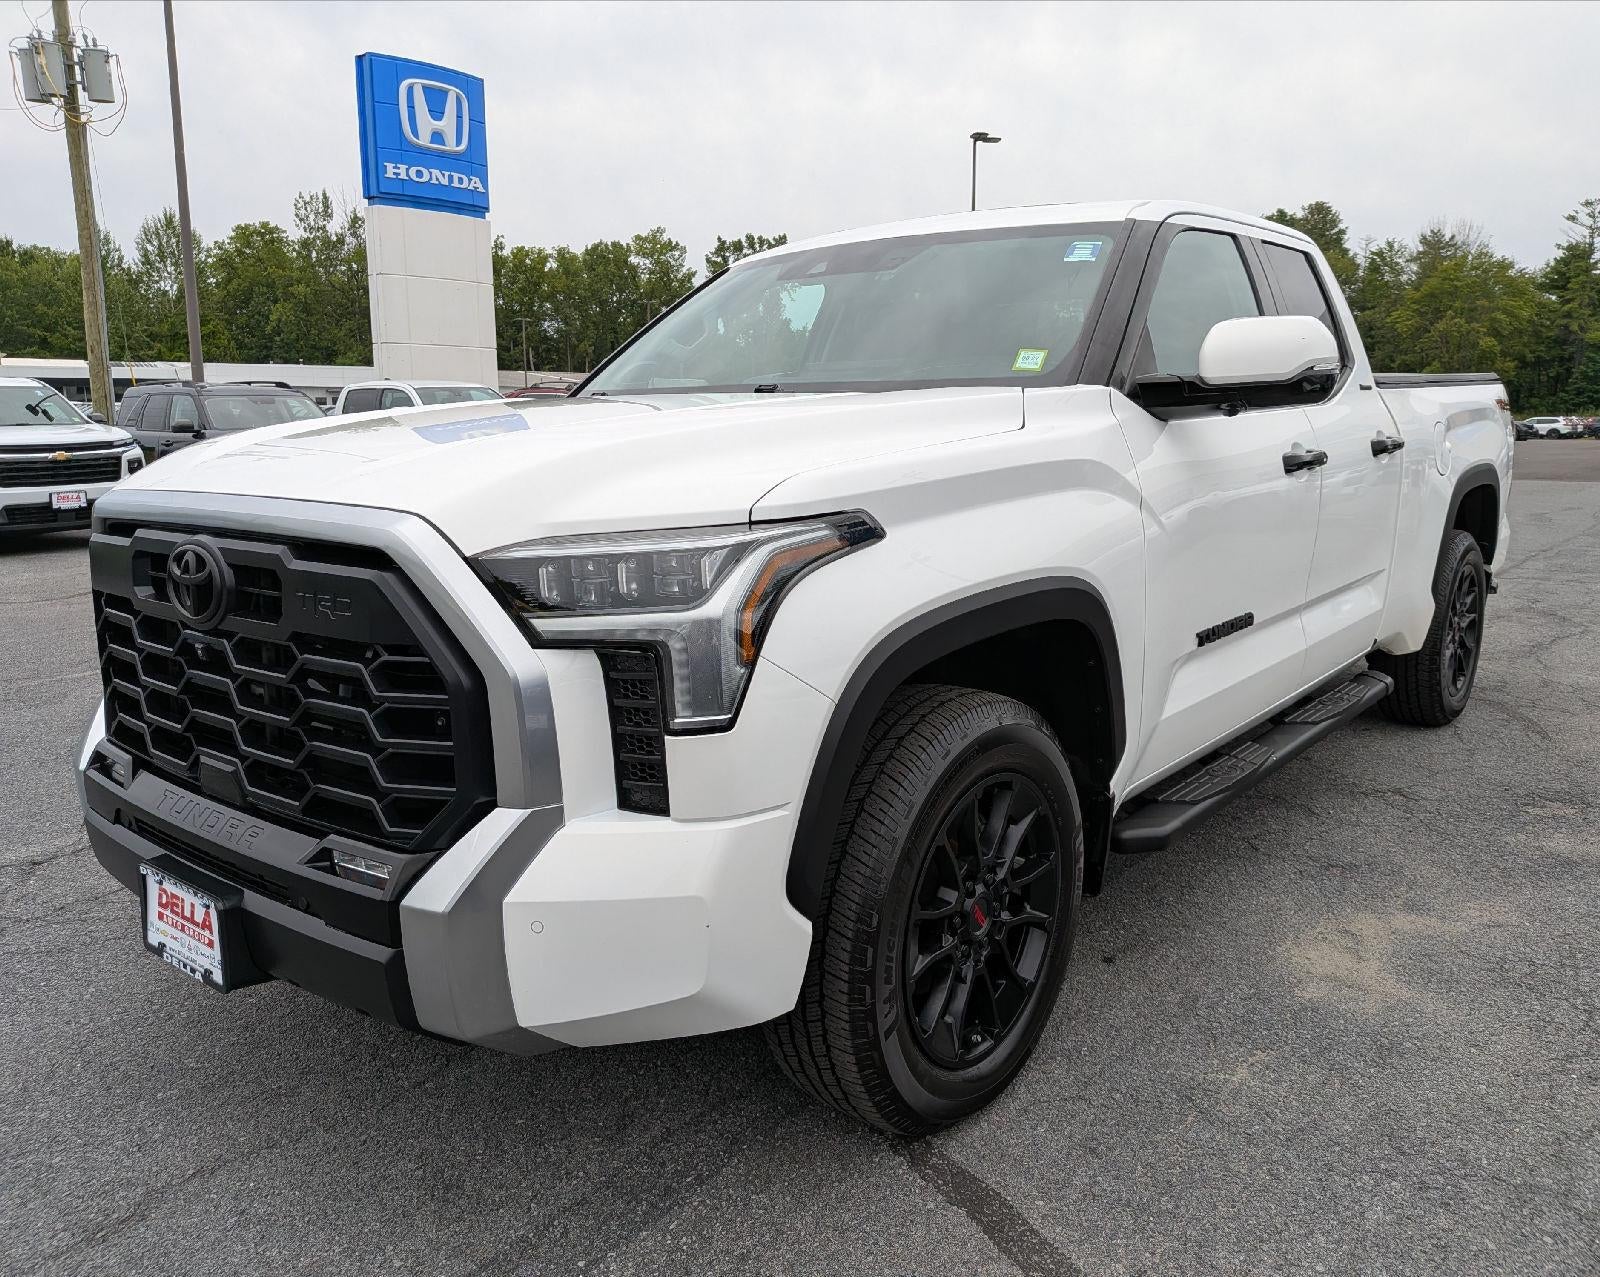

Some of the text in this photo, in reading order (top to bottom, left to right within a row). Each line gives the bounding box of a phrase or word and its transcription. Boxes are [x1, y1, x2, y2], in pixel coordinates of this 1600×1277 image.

[383, 162, 486, 193] HONDA
[296, 592, 352, 621] TRD
[1195, 611, 1255, 648] TUNDRA
[156, 788, 265, 851] TUNDRA
[158, 885, 214, 935] DELLA
[163, 914, 182, 930] AUTO
[184, 926, 210, 945] GROUP
[163, 954, 204, 983] DELLA
